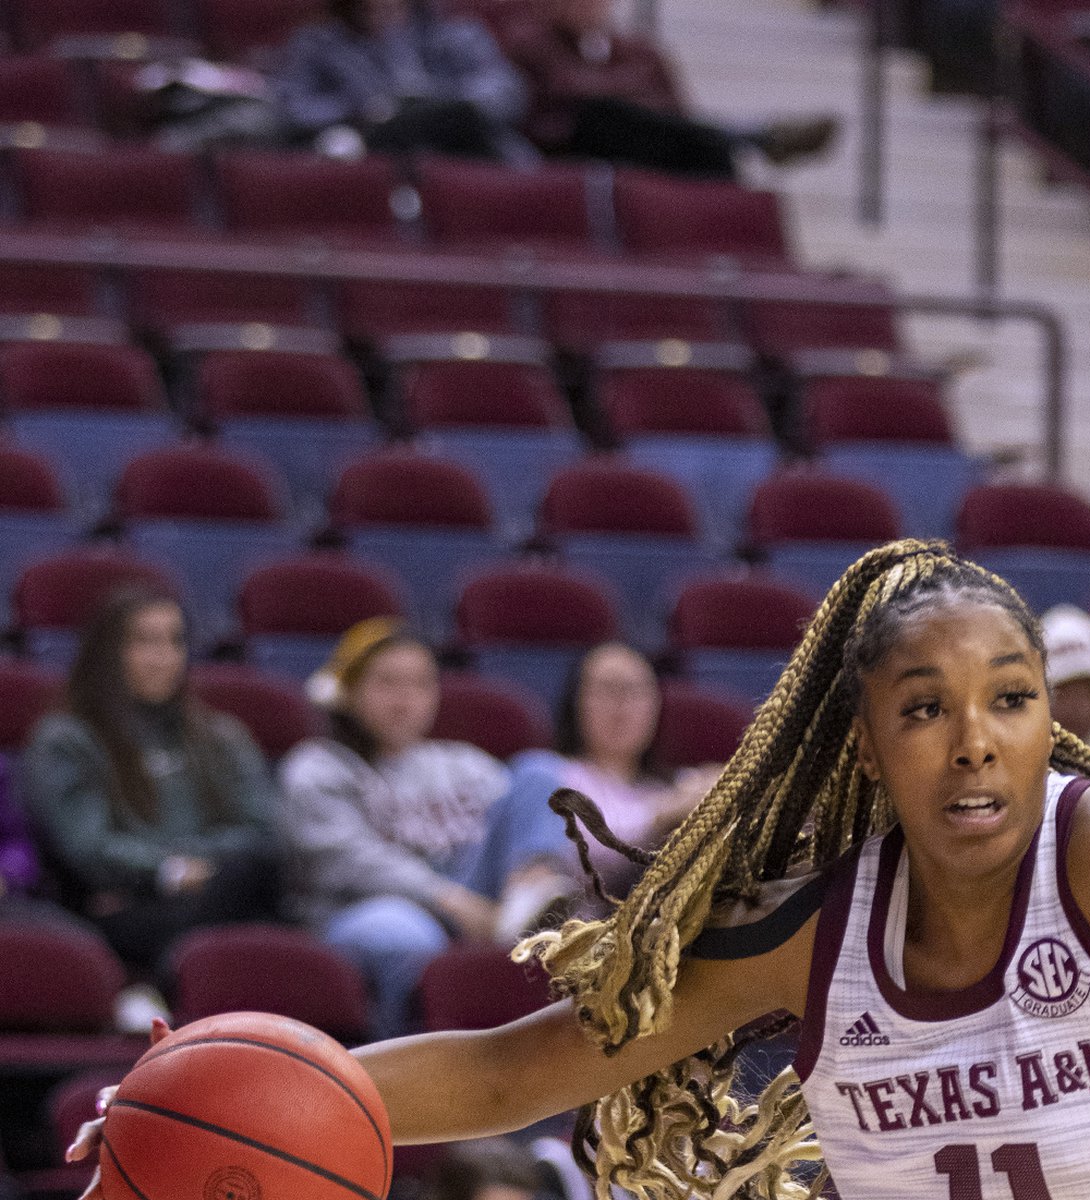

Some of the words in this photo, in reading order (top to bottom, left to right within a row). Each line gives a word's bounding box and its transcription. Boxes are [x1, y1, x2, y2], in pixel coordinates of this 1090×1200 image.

[1021, 941, 1076, 999] SEC
[1022, 986, 1087, 1018] GRADUATE
[839, 1033, 890, 1047] adidas
[835, 1060, 1001, 1132] TEXAS
